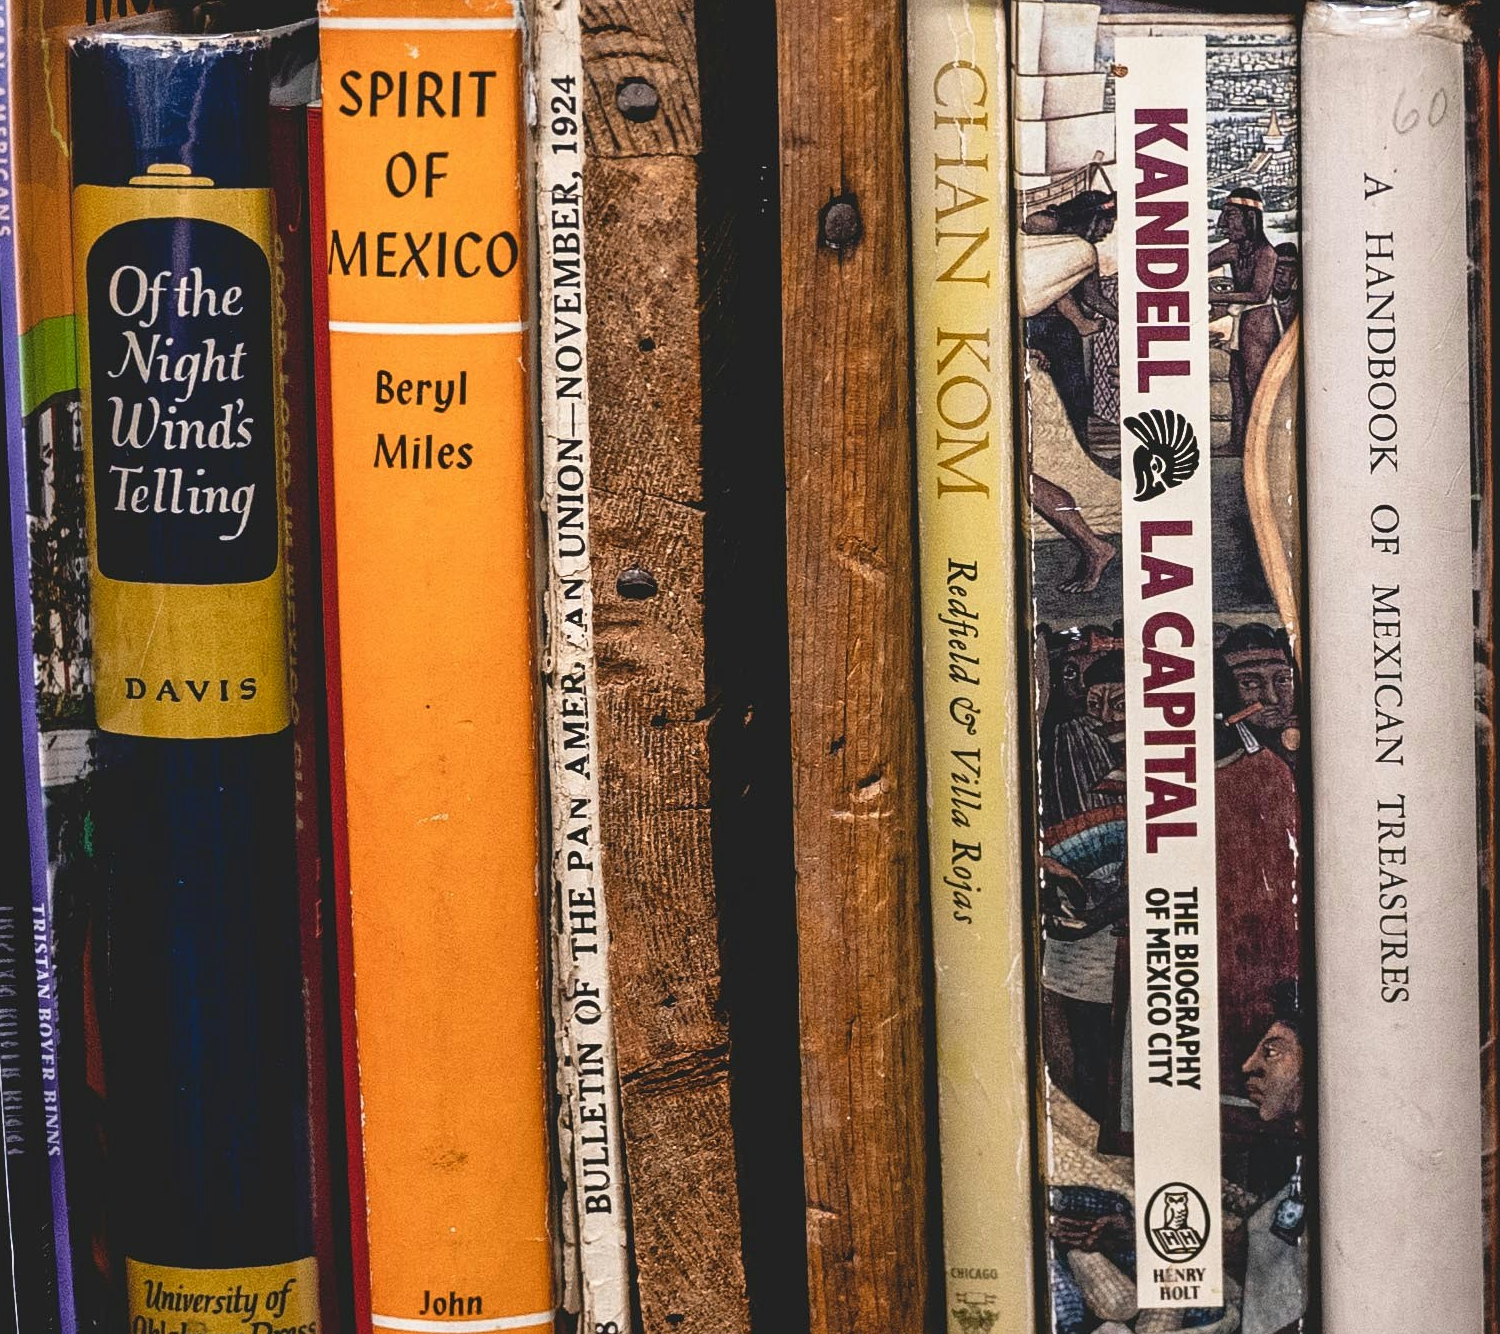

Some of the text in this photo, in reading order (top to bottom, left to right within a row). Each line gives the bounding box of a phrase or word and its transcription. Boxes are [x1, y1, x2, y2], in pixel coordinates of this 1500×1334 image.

[338, 70, 496, 118] SPIRIT
[385, 152, 449, 198] OF
[328, 230, 519, 277] MEXICO
[1133, 108, 1189, 394] KANDELL
[109, 265, 245, 317] Of the
[107, 332, 248, 402] Night
[375, 370, 467, 412] Beryl
[374, 434, 473, 472] Miles
[109, 466, 255, 541] Telling
[1363, 172, 1409, 1005] A HANDBOOK OF MEXICAN TREASURES
[125, 678, 257, 702] DAVIS
[1140, 520, 1199, 854] LA CAPITAL
[1146, 887, 1174, 1088] OF MEXICO CITY
[1173, 886, 1202, 1090] THE BIOGRAPHY
[143, 1279, 293, 1318] University of
[418, 1289, 482, 1315] John
